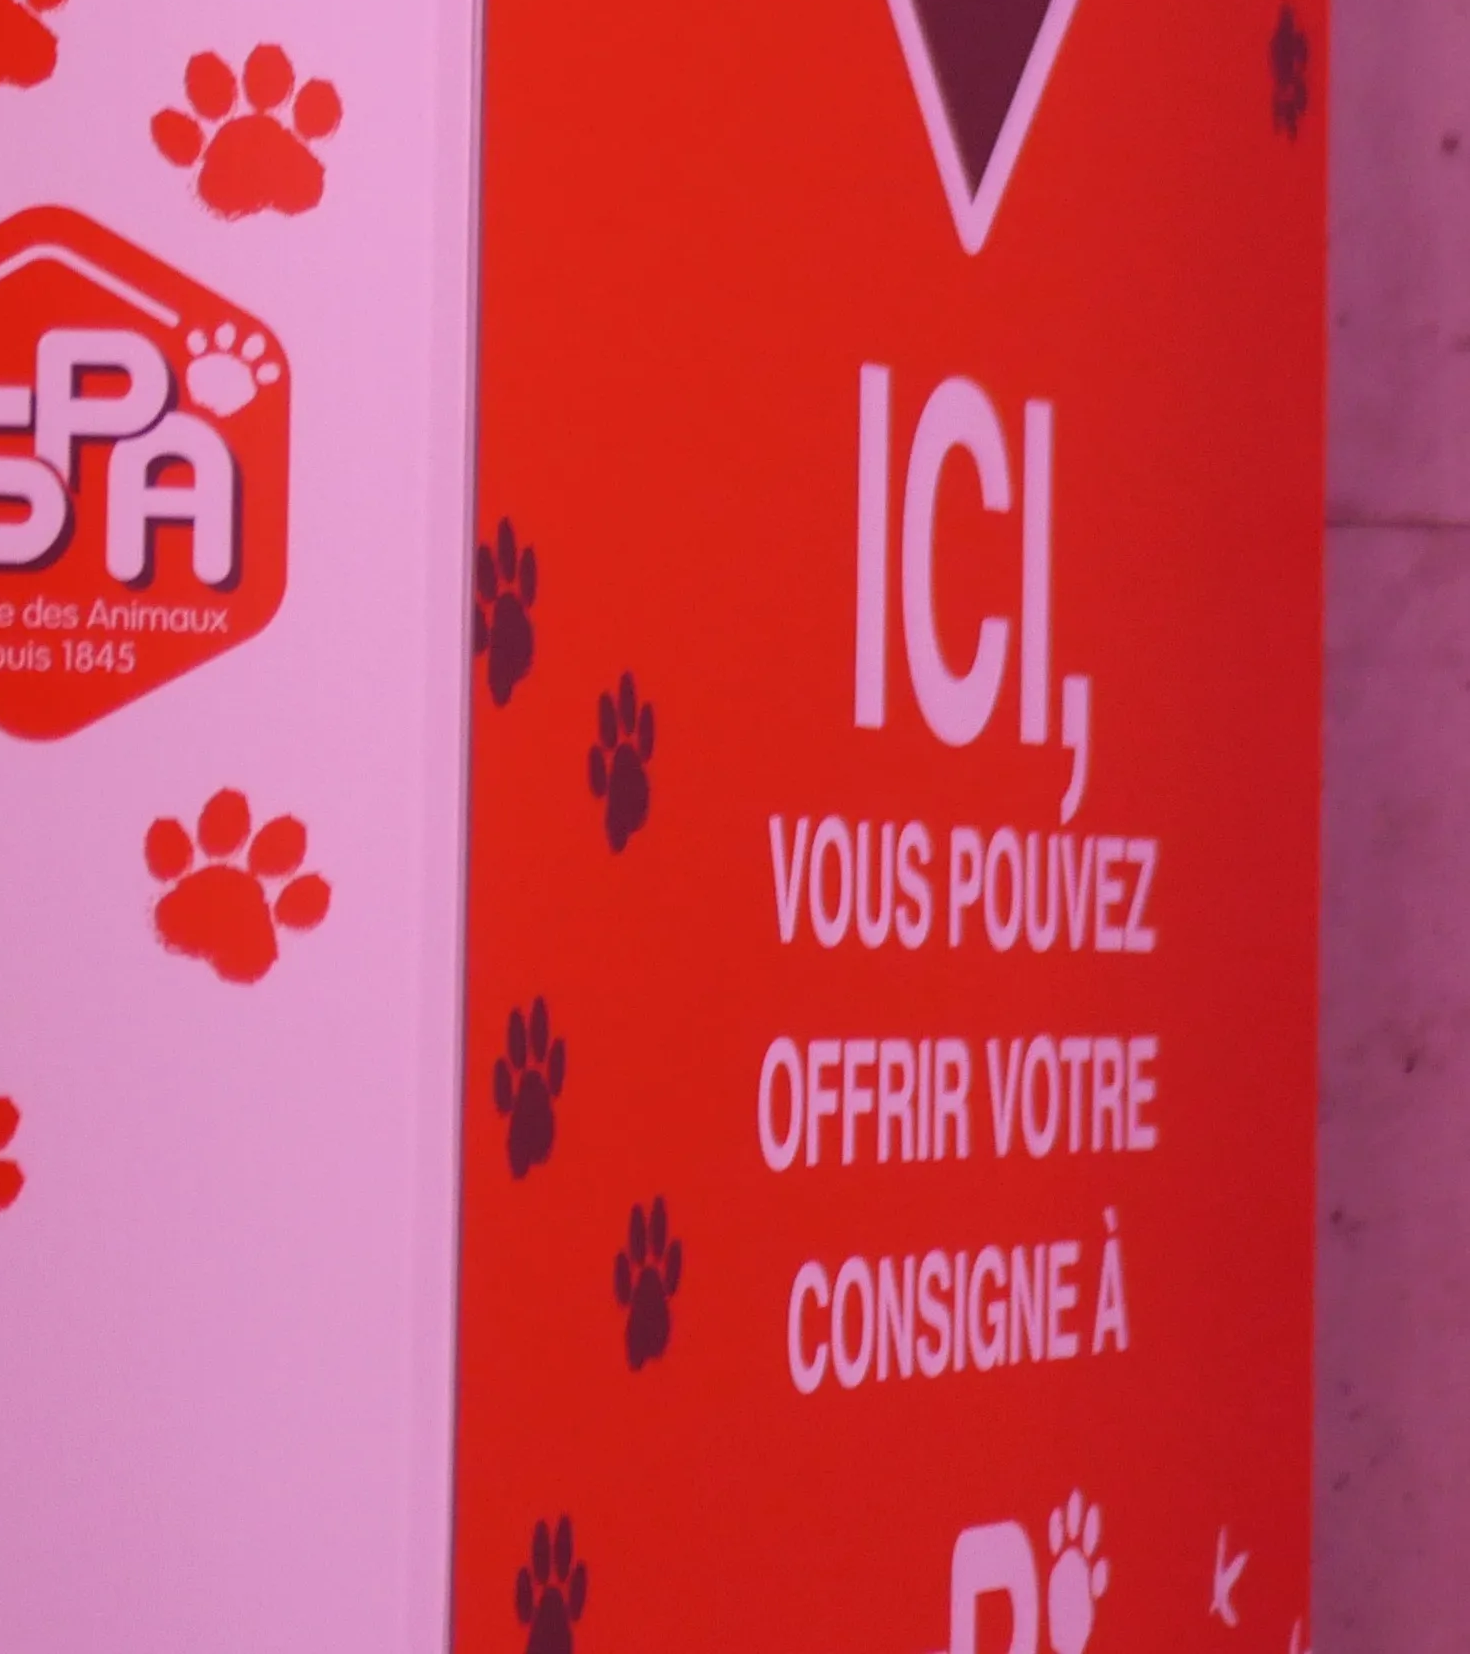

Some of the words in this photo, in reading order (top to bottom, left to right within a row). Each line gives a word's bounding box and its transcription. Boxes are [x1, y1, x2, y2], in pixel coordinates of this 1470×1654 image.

[22, 596, 79, 629] des
[87, 599, 229, 633] Animaux
[63, 640, 136, 673] 1845
[856, 364, 1089, 823] ICI,
[770, 816, 931, 948] VOUS
[949, 828, 1156, 952] POUVEZ
[759, 1038, 970, 1171] OFFRIR
[987, 1035, 1157, 1157] VOTRE
[788, 1242, 1079, 1393] CONSIGNE
[1093, 1208, 1127, 1353] À
